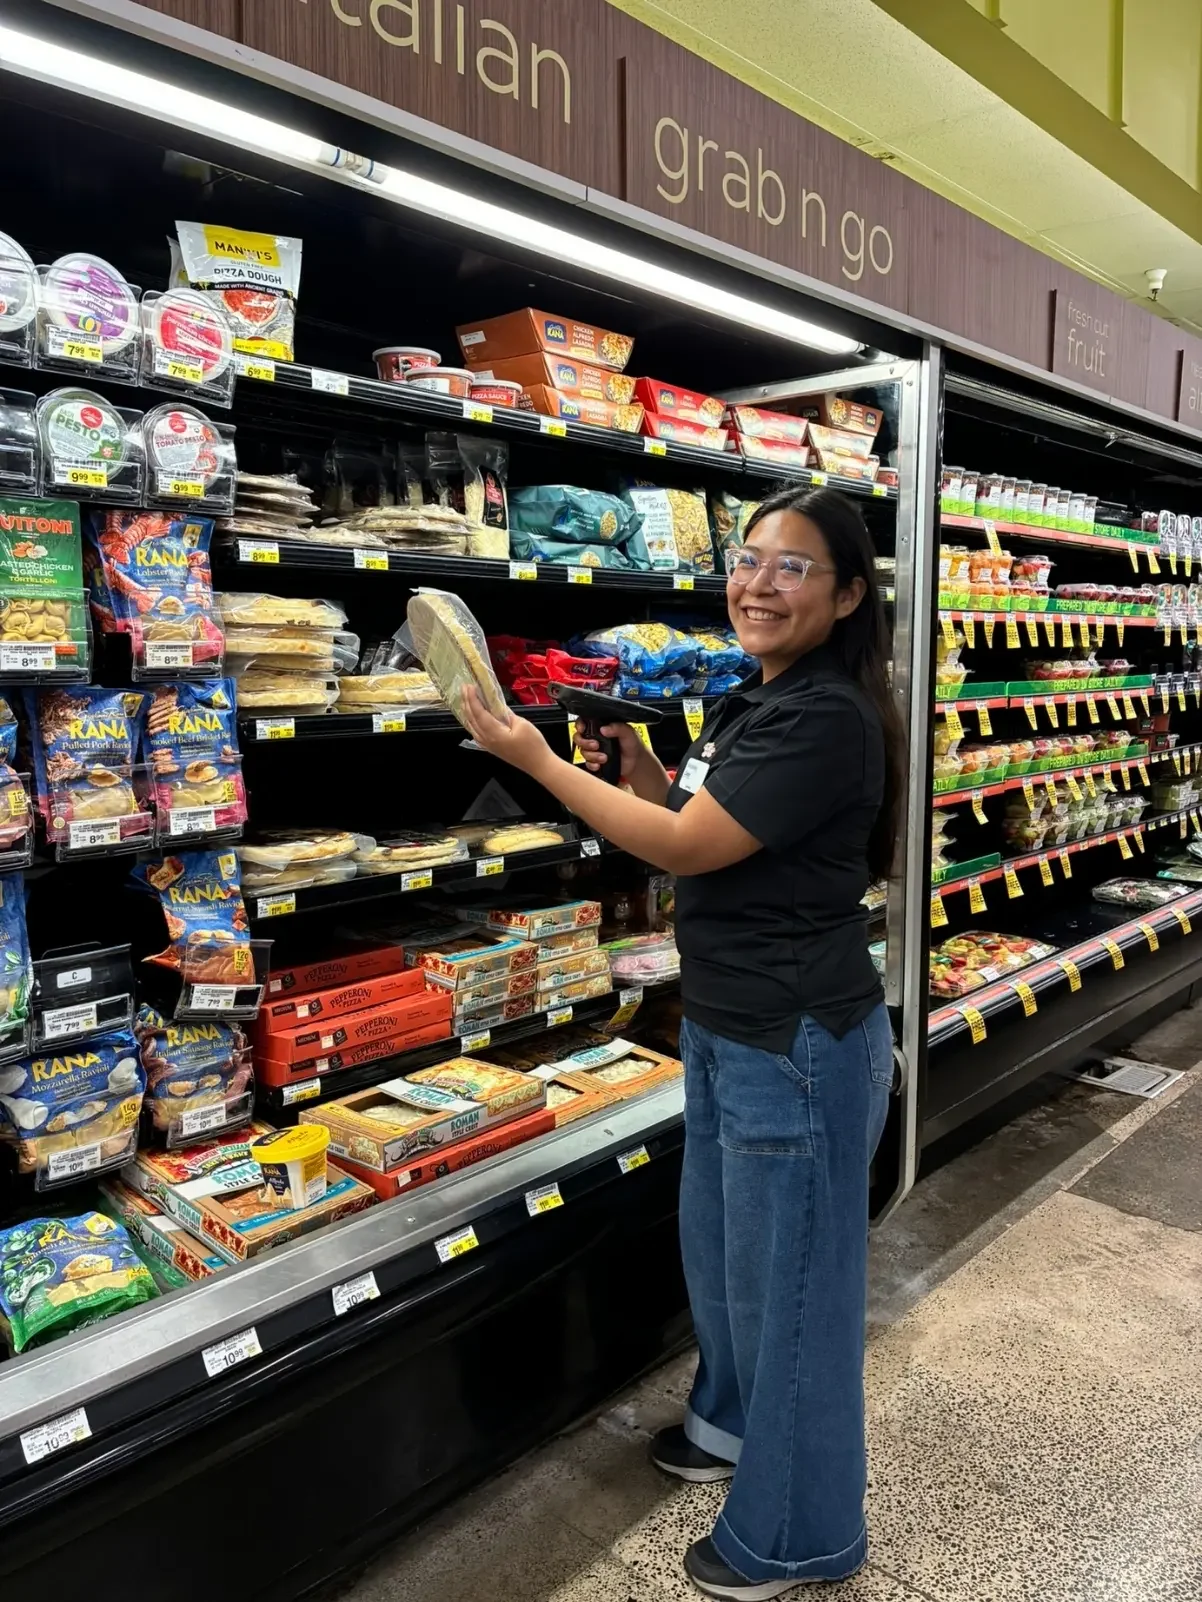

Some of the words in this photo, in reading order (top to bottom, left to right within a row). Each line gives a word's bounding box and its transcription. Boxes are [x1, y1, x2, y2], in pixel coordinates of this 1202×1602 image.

[655, 116, 786, 226] grab
[801, 187, 827, 248] n
[840, 210, 894, 281] go
[213, 268, 246, 278] PIZZA
[247, 270, 283, 285] DOUGH
[1067, 301, 1092, 331] fresh
[1093, 317, 1110, 339] cut
[573, 325, 595, 336] CHICKEN
[573, 332, 595, 343] ALFREDO
[572, 338, 595, 350] LASAGNA
[1067, 328, 1106, 378] fruit
[471, 393, 489, 402] PIZZA
[489, 393, 507, 402] SAUCE
[55, 413, 101, 441] PESTO
[155, 438, 184, 448] TOMATO
[184, 436, 205, 444] PESTO
[0, 513, 73, 535] UITONI
[135, 547, 189, 568] RANA
[0, 560, 33, 569] ASTED
[33, 562, 74, 572] CHICKEN
[20, 568, 54, 577] GARLIC
[137, 568, 168, 578] Lobster
[9, 576, 58, 584] TORTELLONI
[1056, 600, 1082, 612] PREPARED
[935, 685, 953, 699] AILY
[1053, 679, 1080, 692] PREPARED
[69, 719, 129, 740] RANA
[168, 713, 225, 735] RANA
[62, 740, 90, 751] Pulled
[91, 740, 111, 750] Pork
[150, 735, 178, 746] moked
[178, 735, 195, 745] Beef
[196, 733, 222, 743] Brisket
[1049, 753, 1075, 767] PREPARED
[932, 780, 951, 792] AILY
[168, 883, 227, 905] RANA
[303, 962, 348, 985] PEPPERONI
[316, 972, 338, 983] PIZZA
[329, 986, 373, 1009] PEPPERONI
[341, 996, 363, 1007] PIZZA
[354, 1016, 399, 1038] PEPPERONI
[367, 1026, 388, 1037] PIZZA
[458, 1022, 479, 1034] ROMAN
[970, 1018, 986, 1033] FREE
[166, 1023, 222, 1048] RANA
[155, 1047, 181, 1059] Italian
[182, 1043, 212, 1055] Sausage
[212, 1039, 235, 1049] Ravioli
[350, 1040, 396, 1063] PEPPERONI
[31, 1052, 102, 1083] RANA
[31, 1074, 80, 1095] Mozzarella
[80, 1064, 111, 1080] Ravioli
[450, 1111, 480, 1133] ROMAN
[212, 1163, 260, 1184] ROMA
[223, 1177, 251, 1188] STYLE
